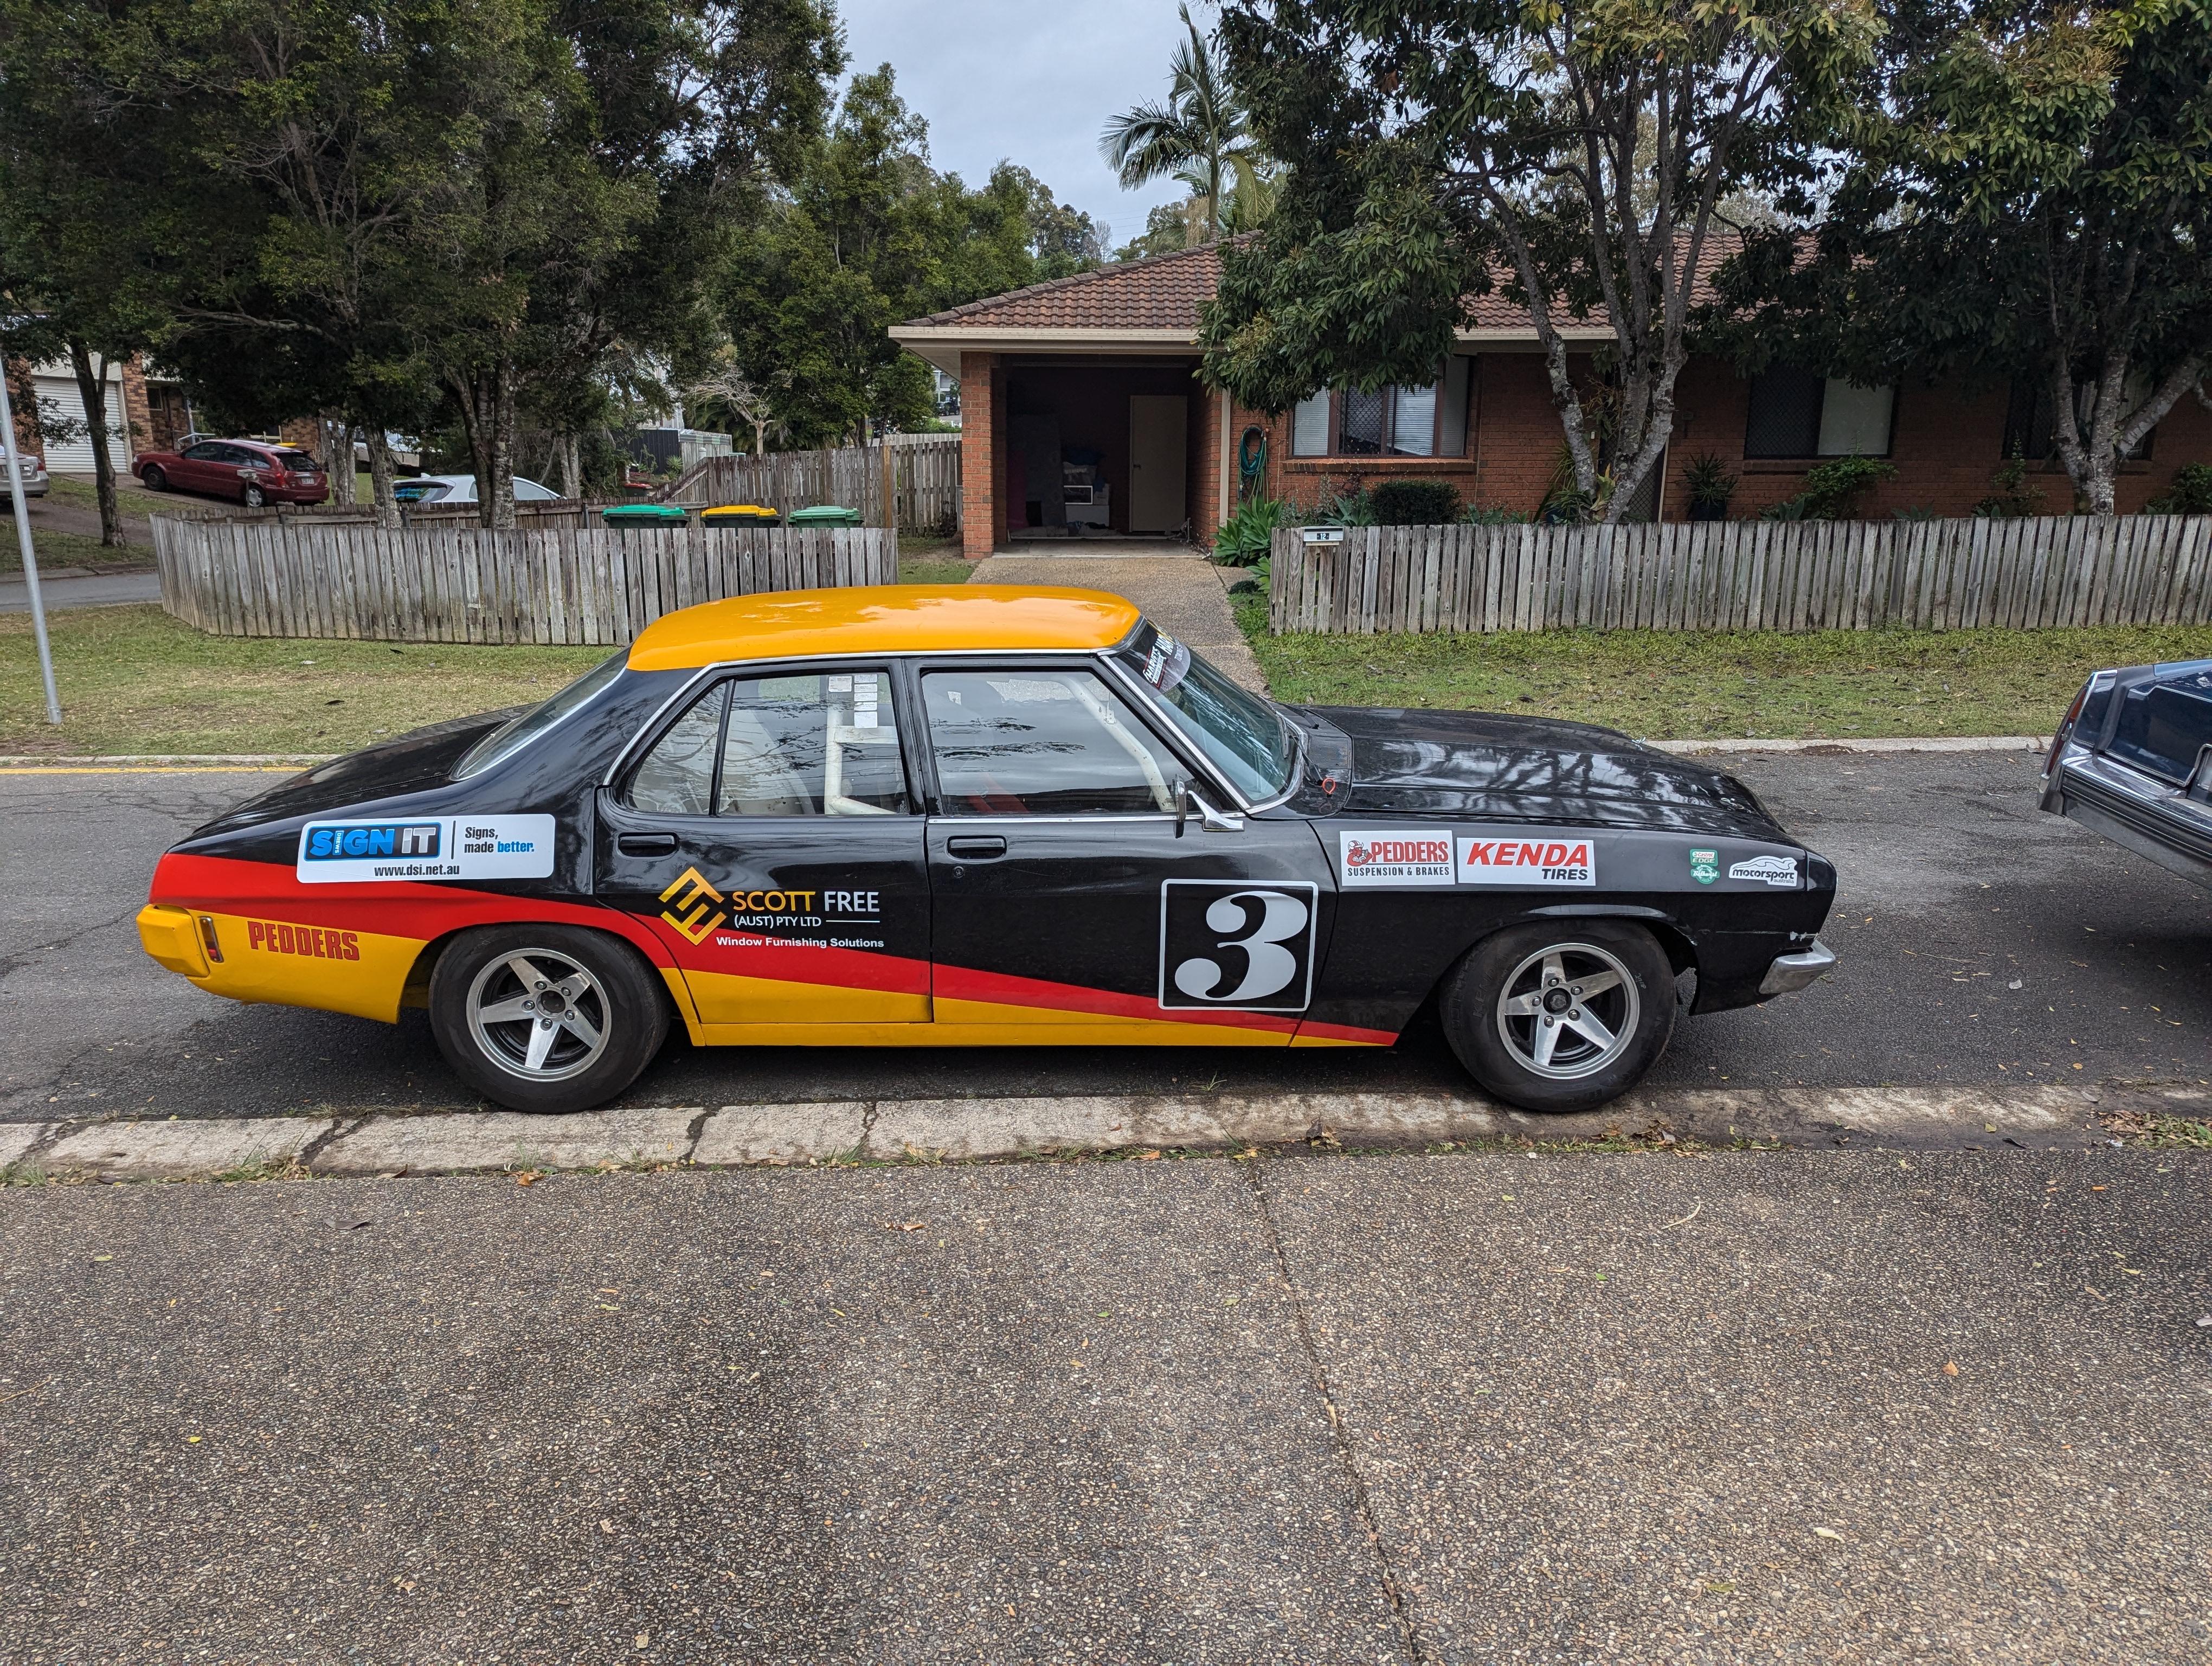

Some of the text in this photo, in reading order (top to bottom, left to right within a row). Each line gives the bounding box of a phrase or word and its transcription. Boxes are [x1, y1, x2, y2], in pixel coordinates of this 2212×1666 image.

[1145, 645, 1161, 680] HARVEYS
[465, 826, 498, 840] Signs,
[310, 828, 436, 856] SIGN IT
[464, 841, 535, 854] made better.
[1371, 841, 1449, 863] PEDDERS
[1467, 842, 1588, 867] KENDA
[374, 863, 460, 877] www.dsi.net.au
[1347, 866, 1450, 877] SUSPENSION & BRAKES
[1541, 868, 1589, 880] TIRES
[1732, 869, 1795, 882] motorsport
[732, 891, 880, 912] SCOTT FREE
[734, 914, 822, 928] (AUST) PTY LTD
[247, 920, 361, 961] PEDDERS
[716, 937, 884, 949] Window Furnishing Solutions
[1175, 891, 1308, 1001] 3
